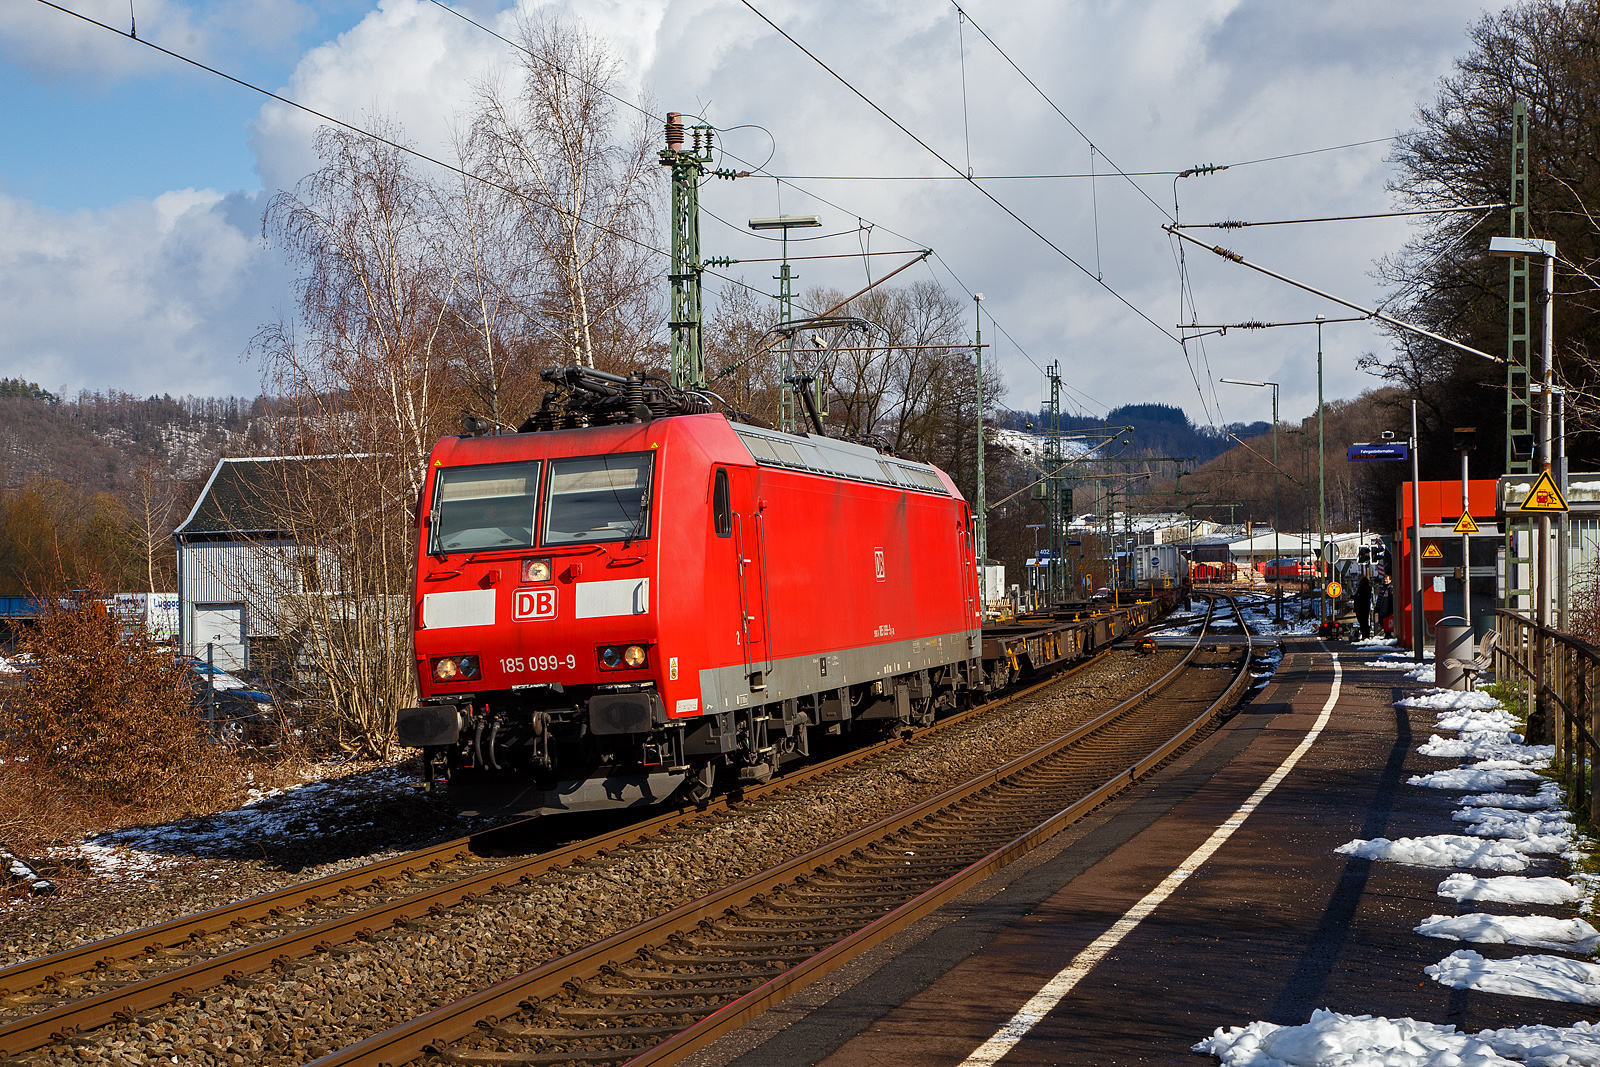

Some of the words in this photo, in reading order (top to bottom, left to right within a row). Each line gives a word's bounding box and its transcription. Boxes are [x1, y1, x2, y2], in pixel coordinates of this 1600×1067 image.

[518, 593, 553, 616] DB
[735, 630, 741, 646] 2
[500, 656, 525, 673] 185
[529, 654, 576, 672] 099-9
